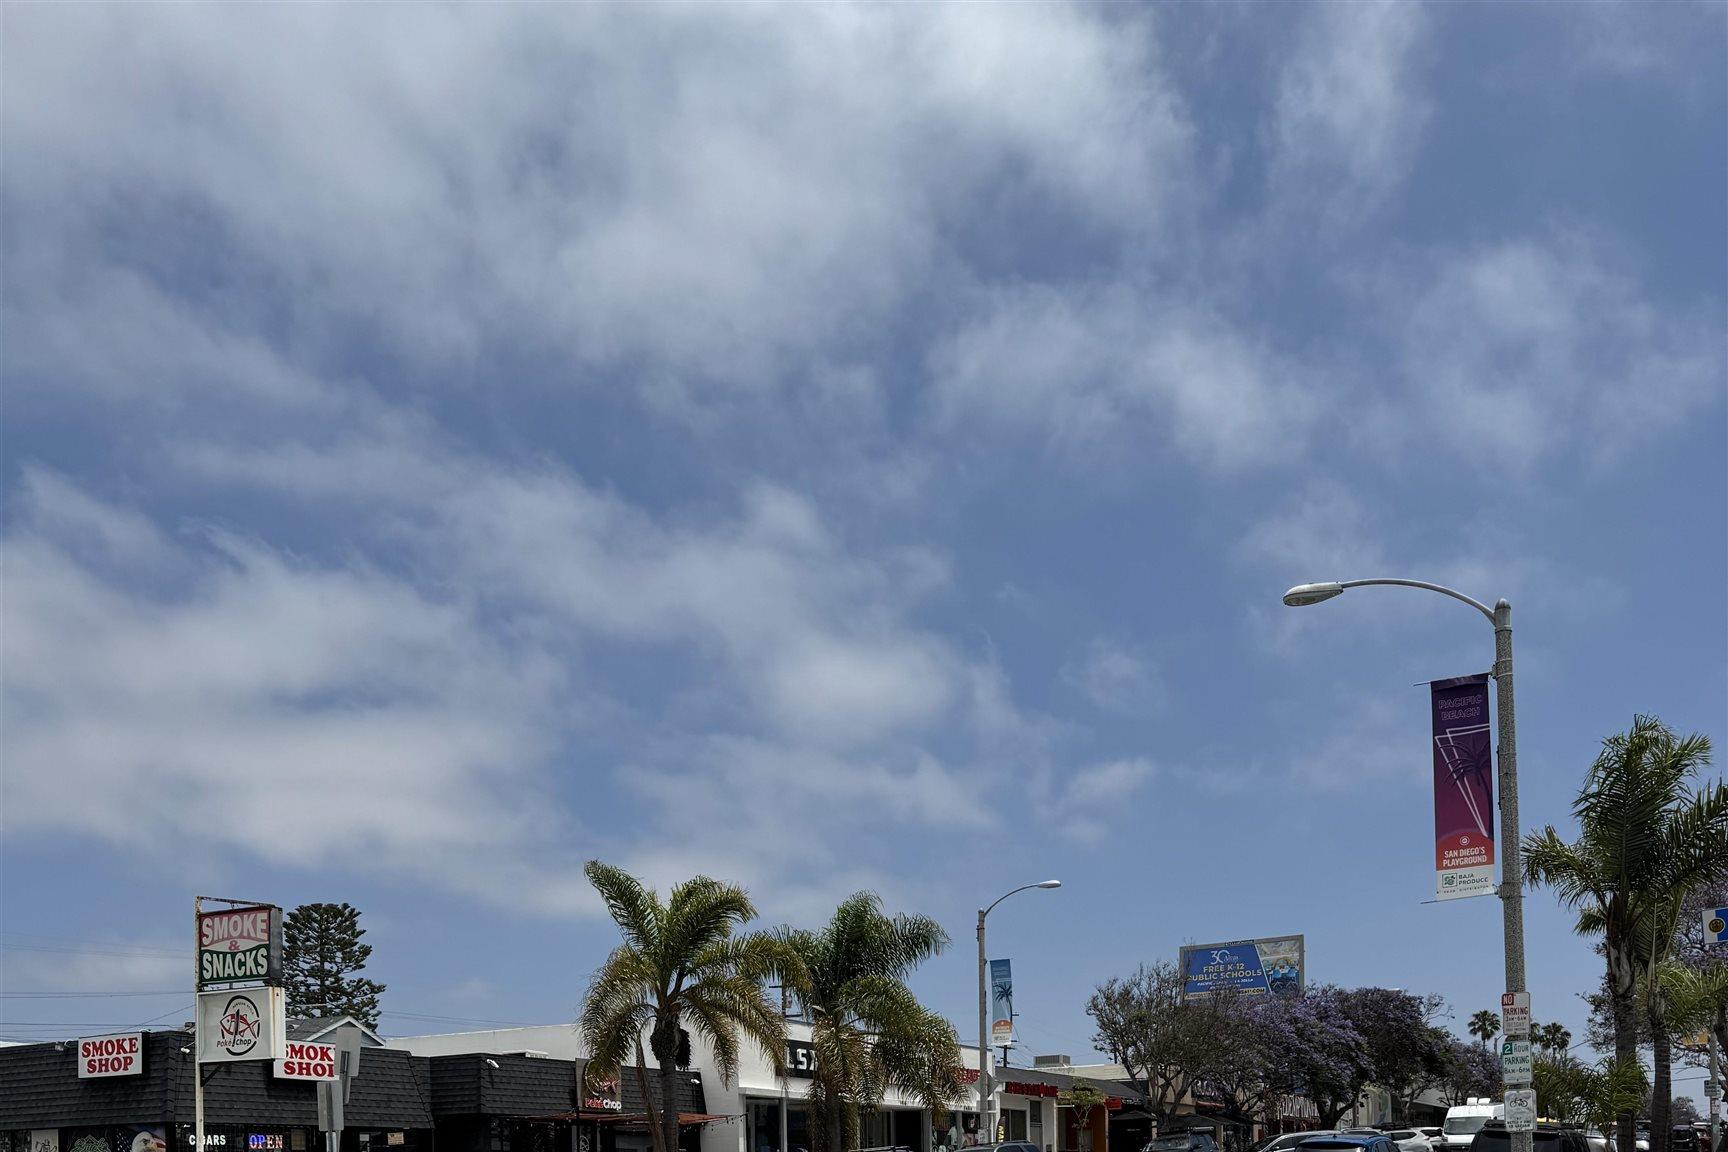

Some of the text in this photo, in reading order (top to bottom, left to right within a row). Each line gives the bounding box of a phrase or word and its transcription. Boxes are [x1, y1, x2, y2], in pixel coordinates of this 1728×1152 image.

[1439, 694, 1483, 709] PACIFIC
[1442, 707, 1481, 720] BEACH
[1444, 846, 1486, 858] SAN DIEGO'S
[1443, 855, 1487, 867] PLAYGROUND
[202, 912, 268, 946] SMOKE
[228, 940, 241, 951] &
[202, 947, 268, 980] SNACKS
[1203, 964, 1225, 973] FREE
[1220, 969, 1262, 979] SCHOOLS
[1503, 995, 1513, 1005] NO
[1504, 1006, 1529, 1016] PARKING
[82, 1037, 139, 1058] SMOKE
[285, 1043, 334, 1062] MOK
[1504, 1044, 1529, 1054] 2 HOUR
[87, 1056, 134, 1074] SHOP
[1505, 1055, 1530, 1065] PARKING
[189, 1134, 226, 1146] CARS
[249, 1134, 283, 1149] OPEN
